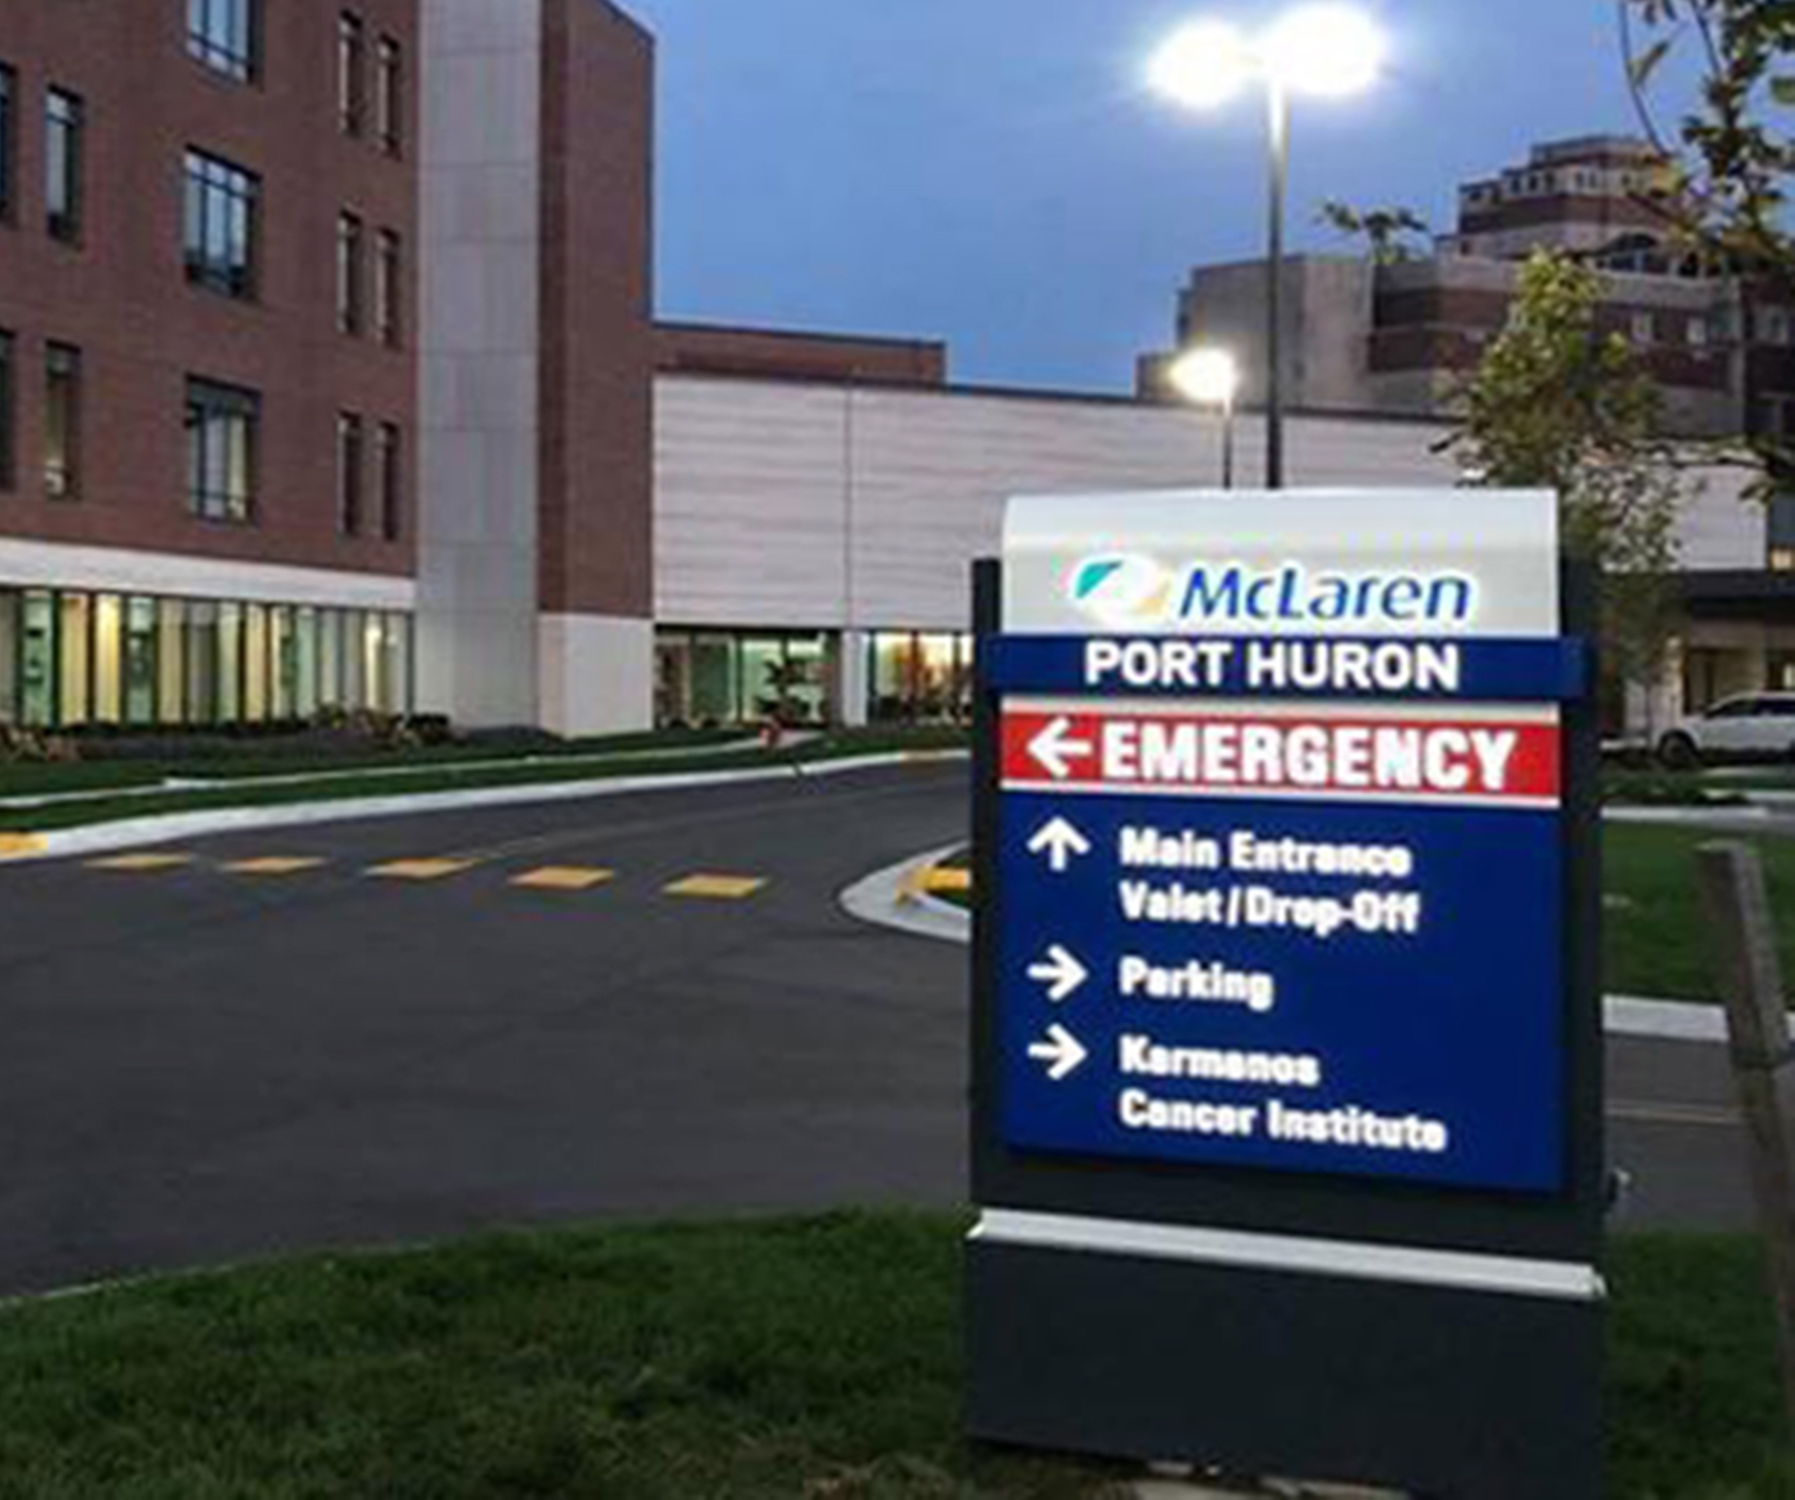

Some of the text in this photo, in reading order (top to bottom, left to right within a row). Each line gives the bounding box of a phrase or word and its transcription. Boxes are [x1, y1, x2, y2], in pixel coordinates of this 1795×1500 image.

[1179, 567, 1471, 620] McLaren
[1084, 641, 1460, 690] PORT HURON
[1104, 721, 1517, 790] EMERGENCY
[1119, 826, 1412, 877] Main Entrance
[1119, 955, 1274, 1011] Parking
[1119, 1090, 1448, 1152] Cancer Institute
